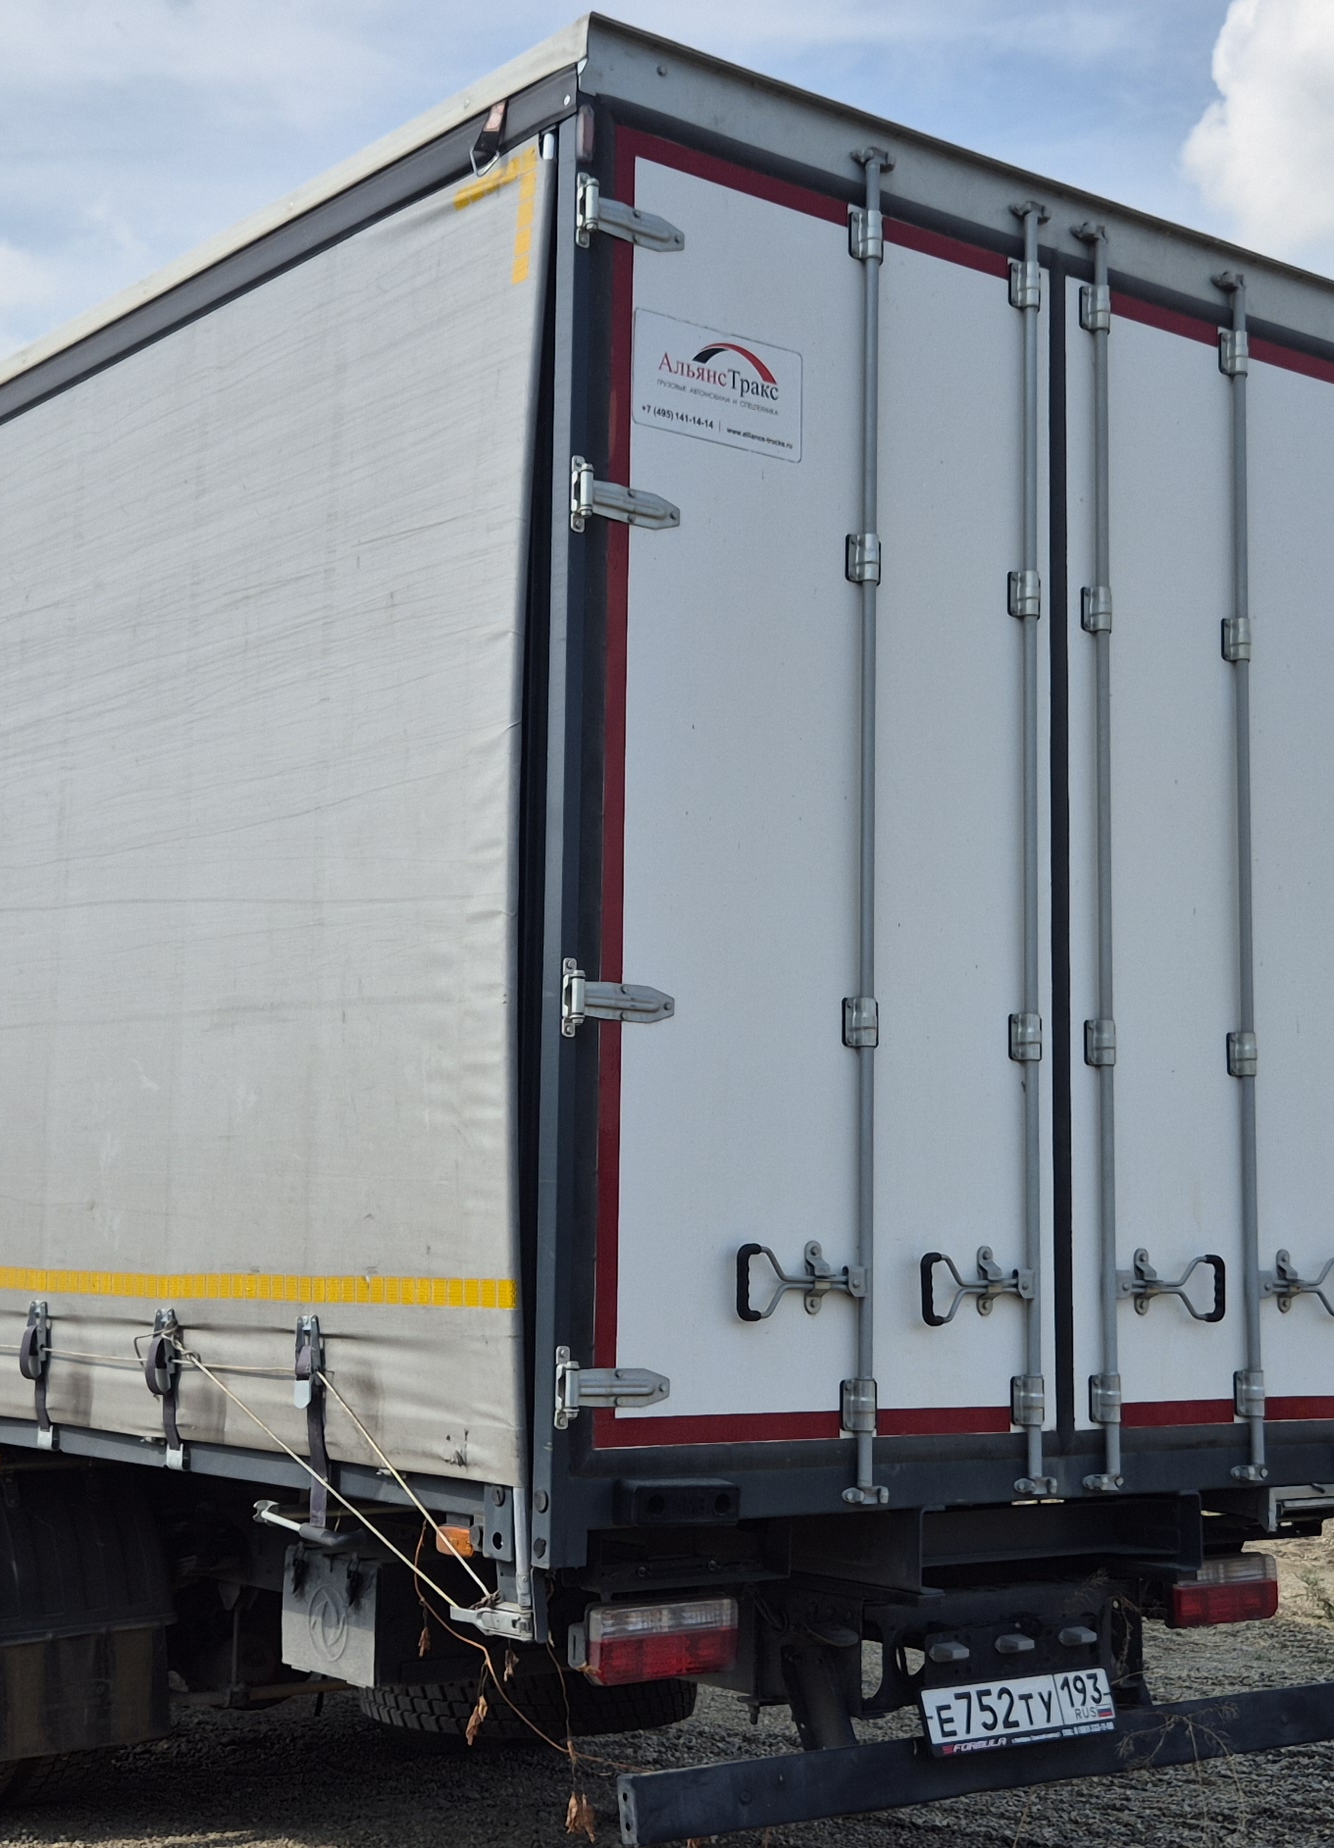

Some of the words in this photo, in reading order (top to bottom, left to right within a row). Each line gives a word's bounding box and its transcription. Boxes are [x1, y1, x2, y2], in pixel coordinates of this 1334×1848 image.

[658, 351, 779, 401] АльянсТракс
[641, 404, 651, 414] +7
[653, 406, 674, 421] (495)
[675, 411, 714, 430] 141-14-14
[935, 1687, 1053, 1738] Е752ТУ
[1060, 1673, 1102, 1708] 193
[1075, 1706, 1097, 1719] RUS
